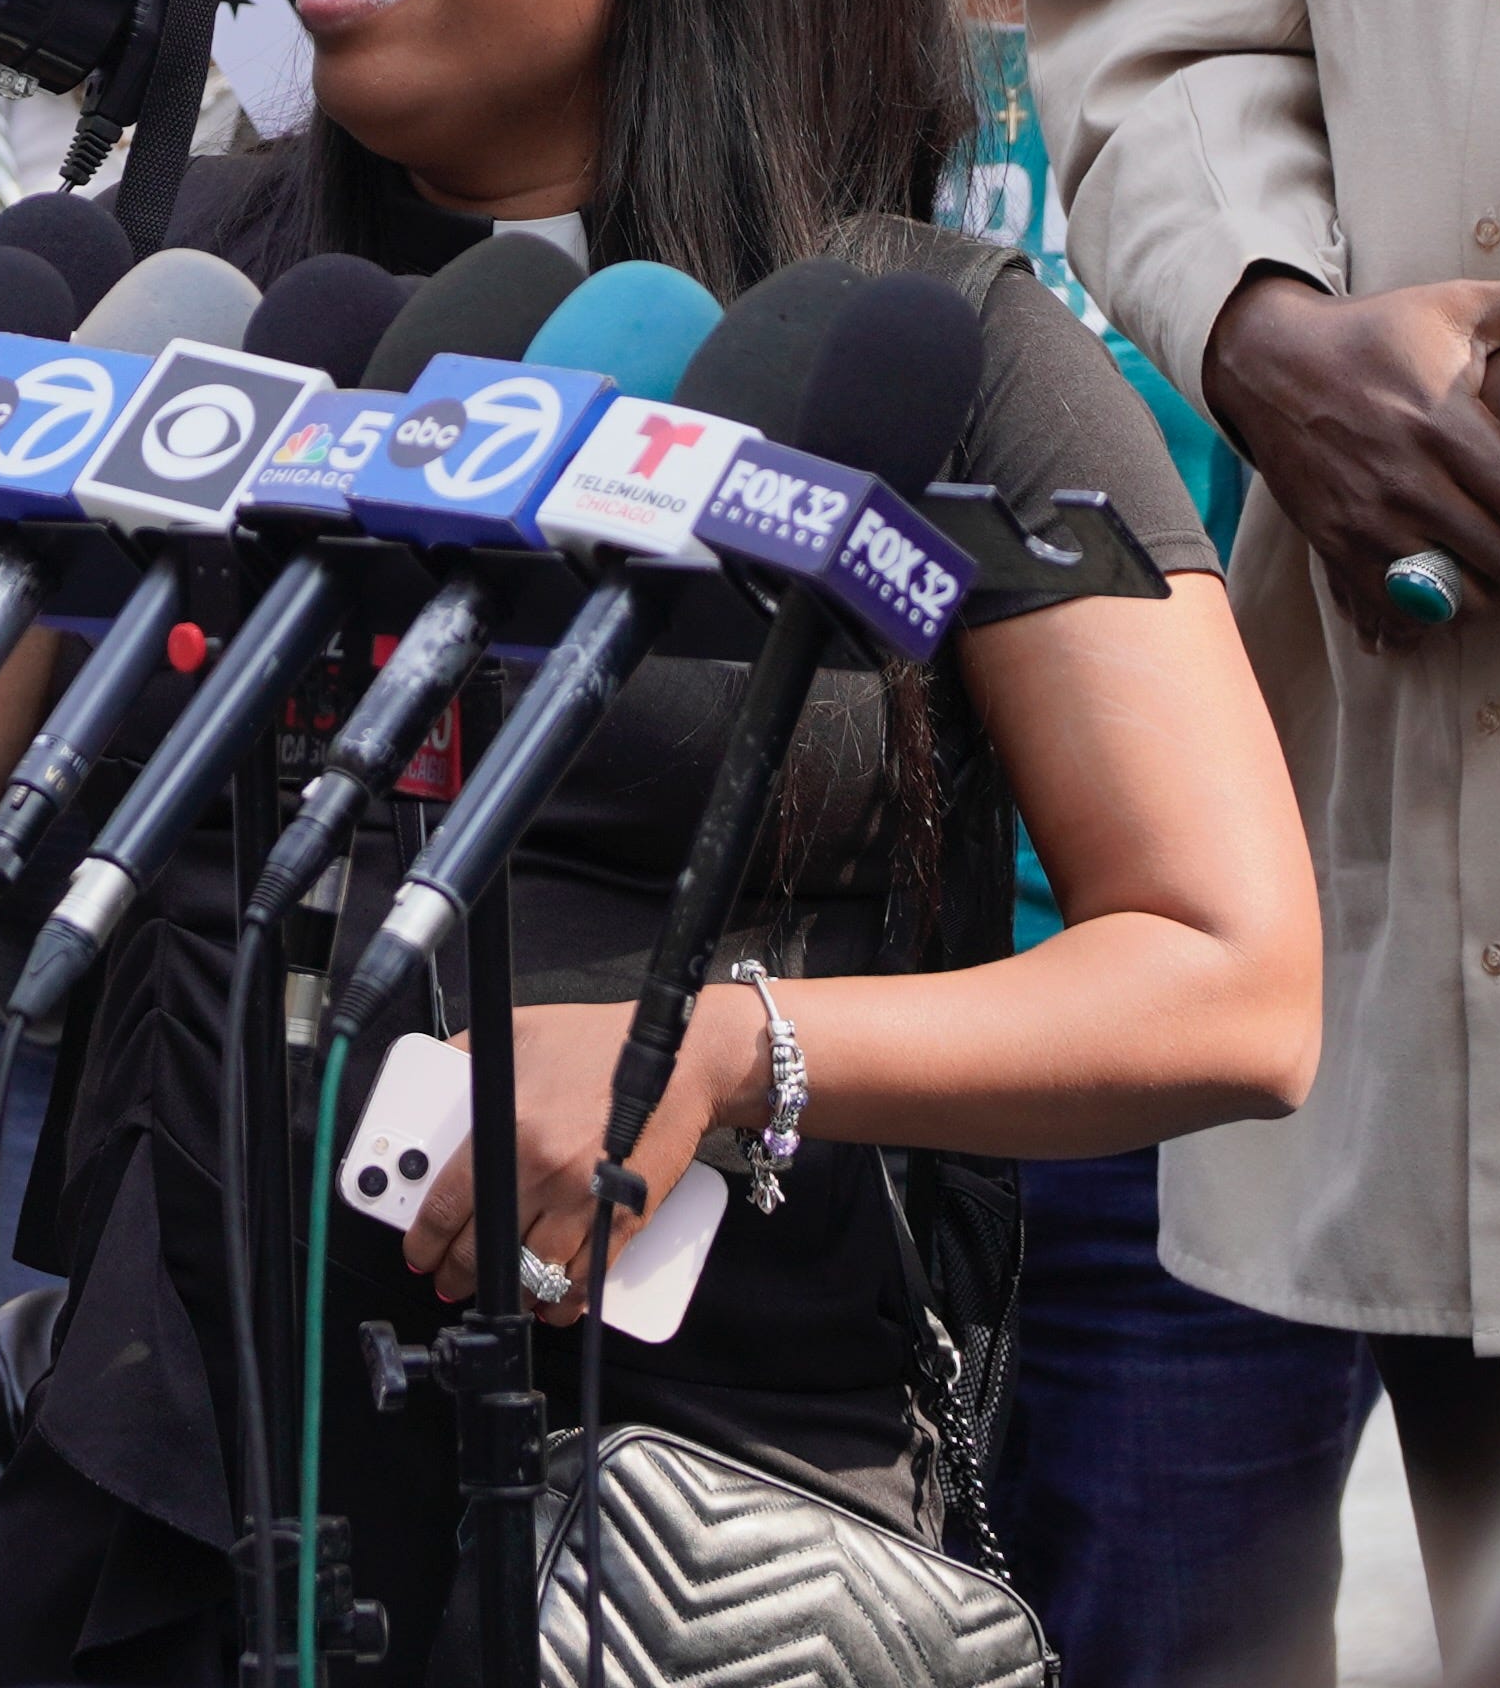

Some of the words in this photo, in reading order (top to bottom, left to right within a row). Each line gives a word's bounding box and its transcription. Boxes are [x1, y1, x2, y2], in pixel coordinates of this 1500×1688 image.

[326, 410, 396, 471] 5
[395, 416, 460, 450] abc
[423, 376, 563, 502] 7
[571, 472, 688, 515] TELEMUNDO
[710, 500, 826, 550] CHICAGO
[717, 459, 805, 528] FOX
[795, 485, 850, 534] 32
[838, 550, 938, 636] CHICAGO
[846, 507, 915, 593] FOX
[908, 560, 960, 620] 32
